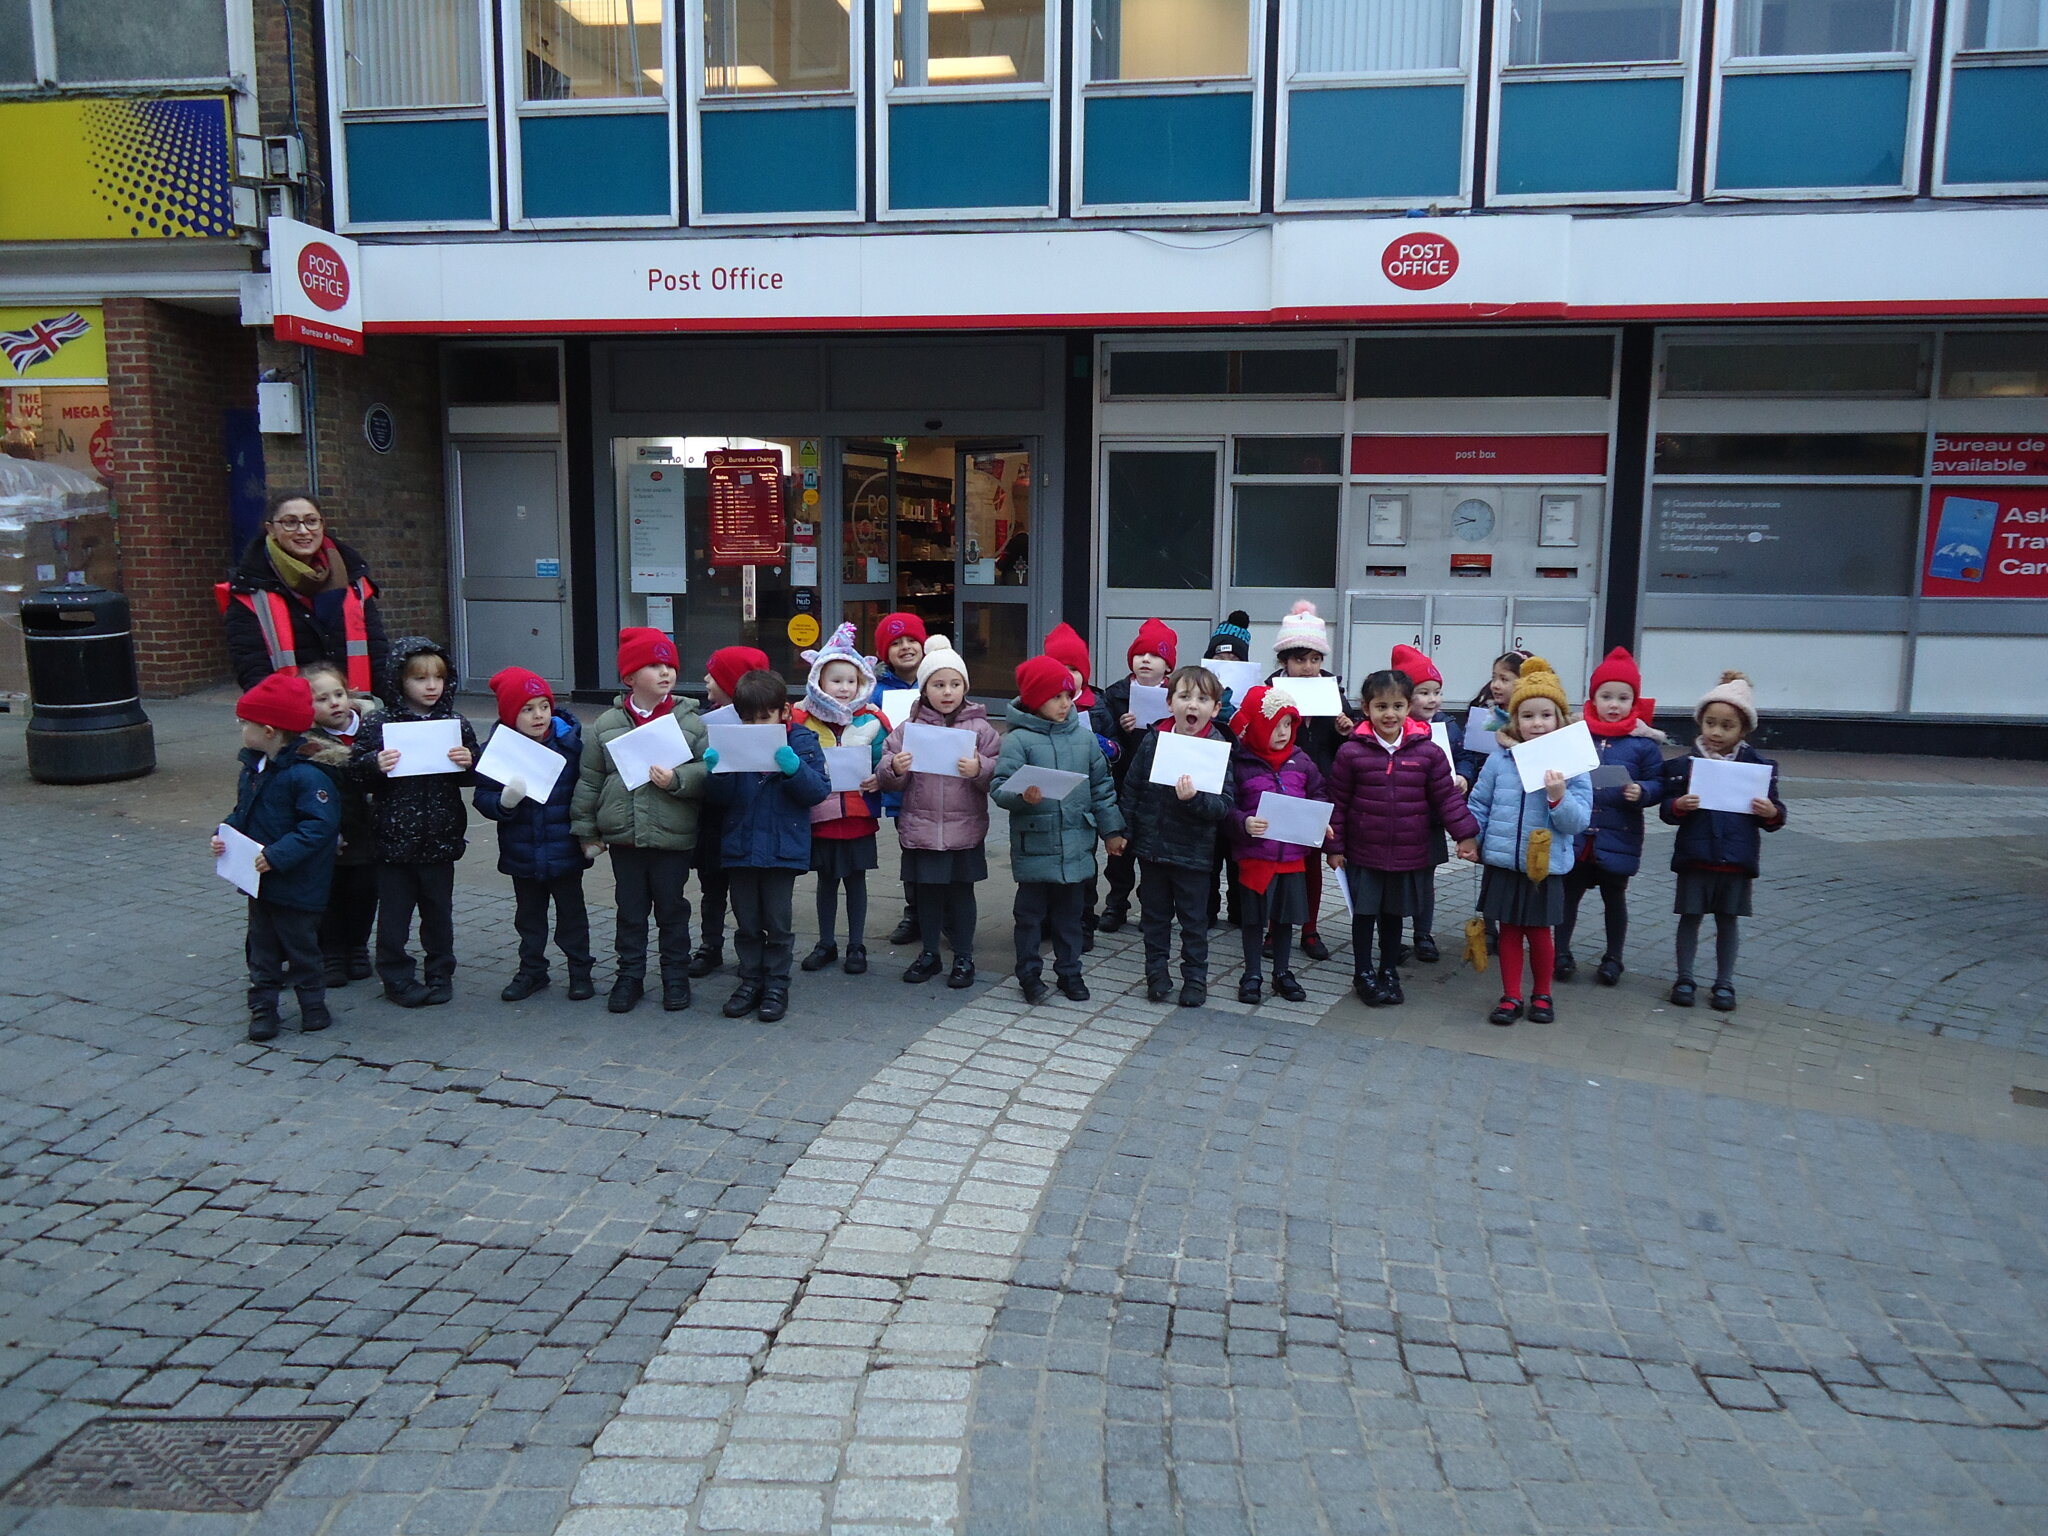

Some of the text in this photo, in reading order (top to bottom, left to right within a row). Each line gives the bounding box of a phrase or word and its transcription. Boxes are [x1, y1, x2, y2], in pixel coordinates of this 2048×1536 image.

[1399, 243, 1445, 259] POST
[309, 254, 339, 277] POST
[1388, 260, 1450, 276] OFFICE
[302, 271, 344, 298] OFFICE
[648, 267, 783, 291] Post Office
[301, 325, 354, 347] Bureau de Change
[18, 393, 40, 404] THE
[61, 406, 101, 419] MEGA
[1934, 438, 2046, 452] Bureau de
[1455, 449, 1496, 460] post box
[1931, 458, 2028, 472] available
[796, 597, 811, 605] hub
[1413, 634, 1421, 646] A
[1434, 634, 1441, 646] B
[1515, 637, 1523, 649] C
